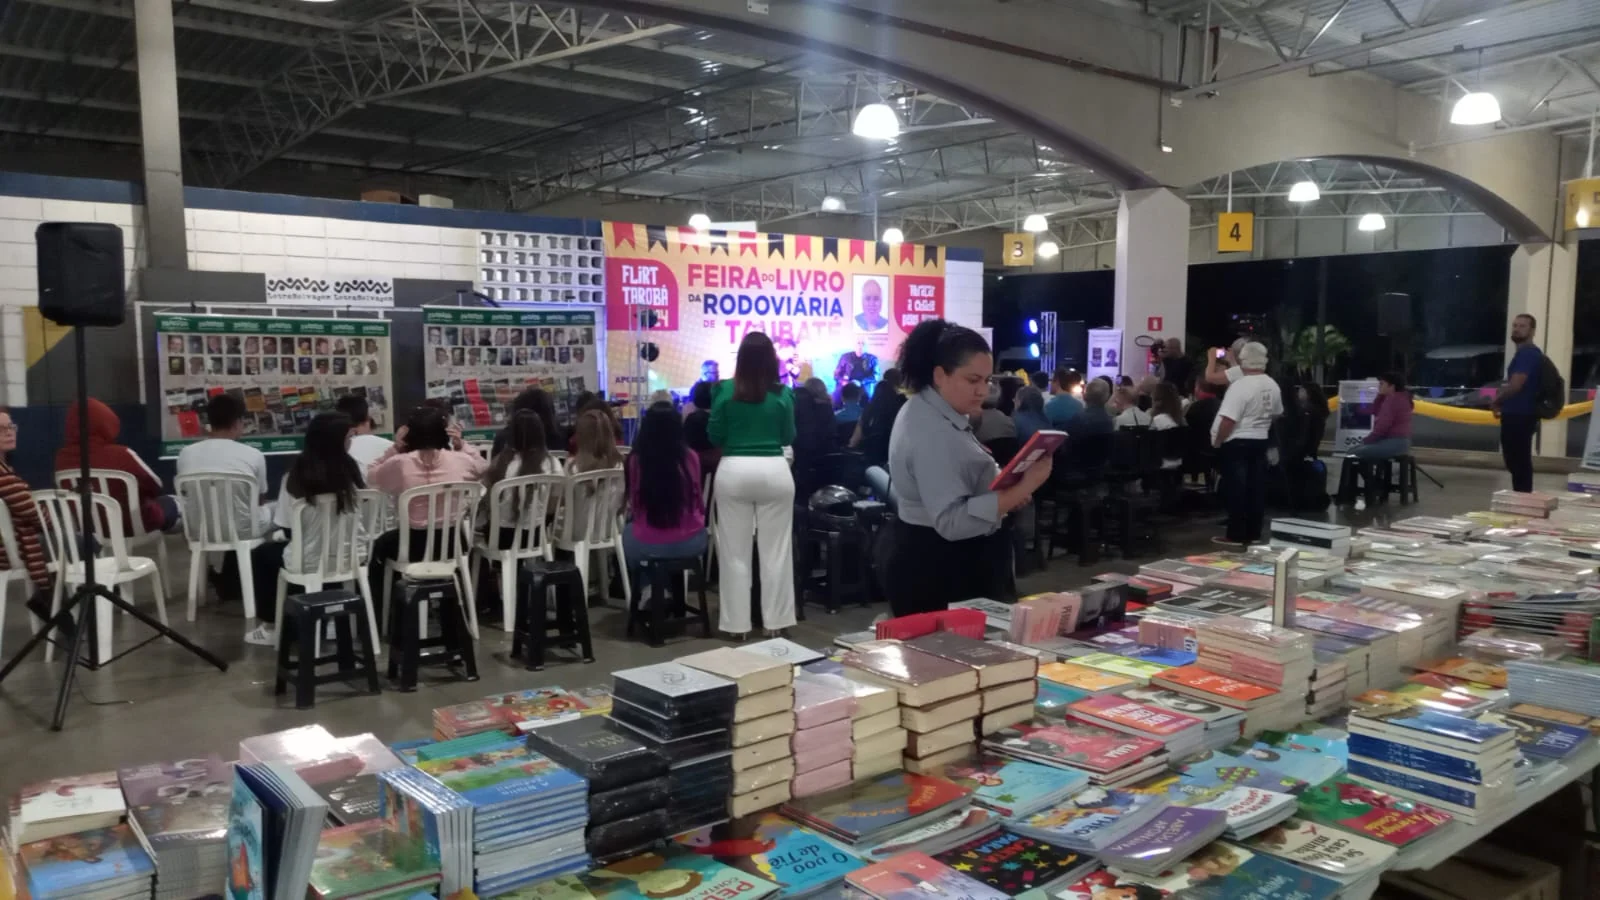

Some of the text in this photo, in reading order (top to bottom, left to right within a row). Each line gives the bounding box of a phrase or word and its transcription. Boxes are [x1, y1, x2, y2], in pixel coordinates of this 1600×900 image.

[1229, 222, 1242, 242] 4
[1012, 241, 1025, 258] 3
[687, 263, 845, 292] FEIRA DO LIVRO
[687, 291, 844, 317] DA RODOVIÁRIA
[703, 319, 716, 329] DE
[799, 844, 820, 857] de
[793, 852, 849, 874] O voo
